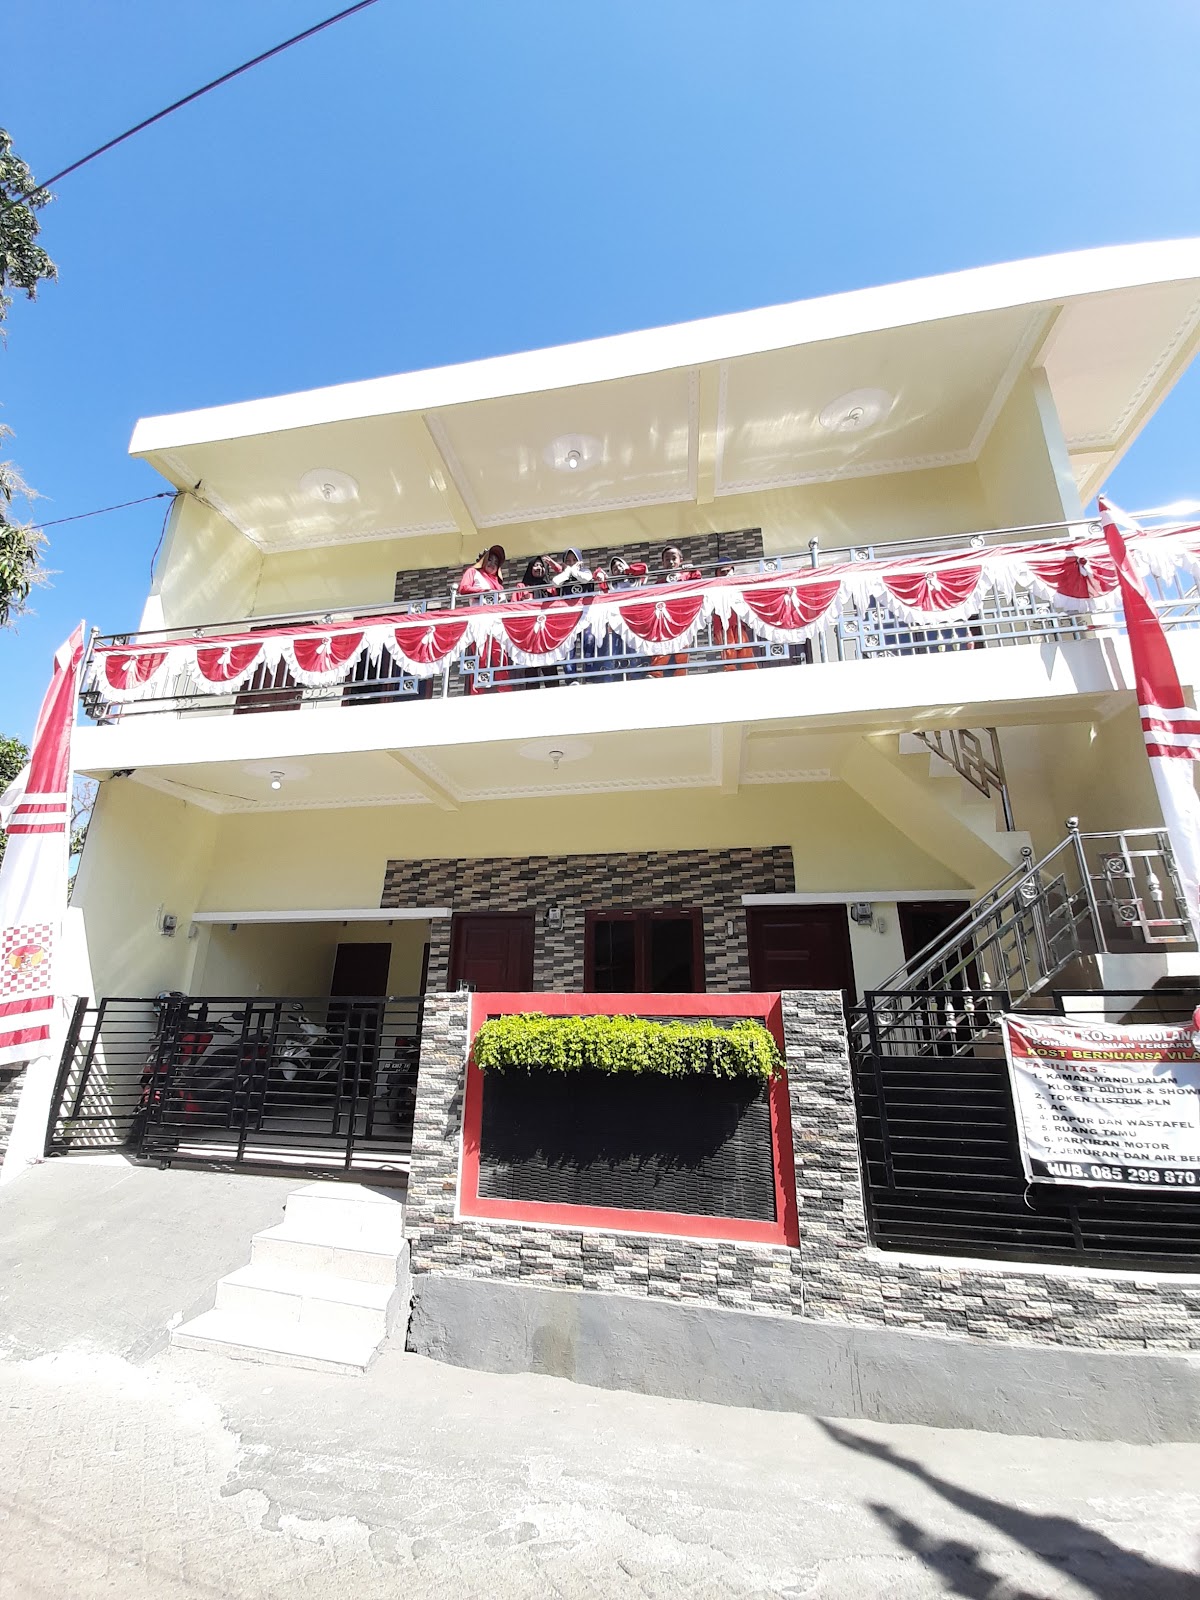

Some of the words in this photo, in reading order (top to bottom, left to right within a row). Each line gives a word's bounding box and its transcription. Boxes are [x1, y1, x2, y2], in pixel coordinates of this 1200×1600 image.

[1022, 1027, 1074, 1040] RUMH
[1081, 1029, 1123, 1041] KOST
[1026, 1047, 1068, 1057] KOST
[1071, 1050, 1163, 1060] BERNUANSA
[1025, 1062, 1098, 1073] FASILITAS
[1046, 1073, 1090, 1082] KAMAR
[1094, 1076, 1133, 1084] MANDI
[1047, 1083, 1095, 1093] KLOSET
[1099, 1086, 1142, 1094] DUDUK
[1048, 1094, 1090, 1103] TOKEN
[1094, 1097, 1143, 1105] LISTRIK
[1050, 1104, 1068, 1112] AC
[1052, 1114, 1094, 1124] DAPUR
[1098, 1118, 1123, 1126] DAN
[1126, 1119, 1195, 1128] WASTAFEL
[1054, 1125, 1098, 1135] RUANG
[1102, 1129, 1137, 1137] TAMU
[1057, 1136, 1120, 1147] PARKIRAN
[1124, 1141, 1170, 1150] MOTOR
[1045, 1146, 1057, 1154] 7.
[1060, 1147, 1119, 1158] JEMURAN
[1123, 1152, 1150, 1160] DAN
[1046, 1162, 1089, 1178] HUB.
[1090, 1165, 1123, 1180] 085
[1127, 1168, 1160, 1182] 299
[1163, 1170, 1196, 1184] 870
